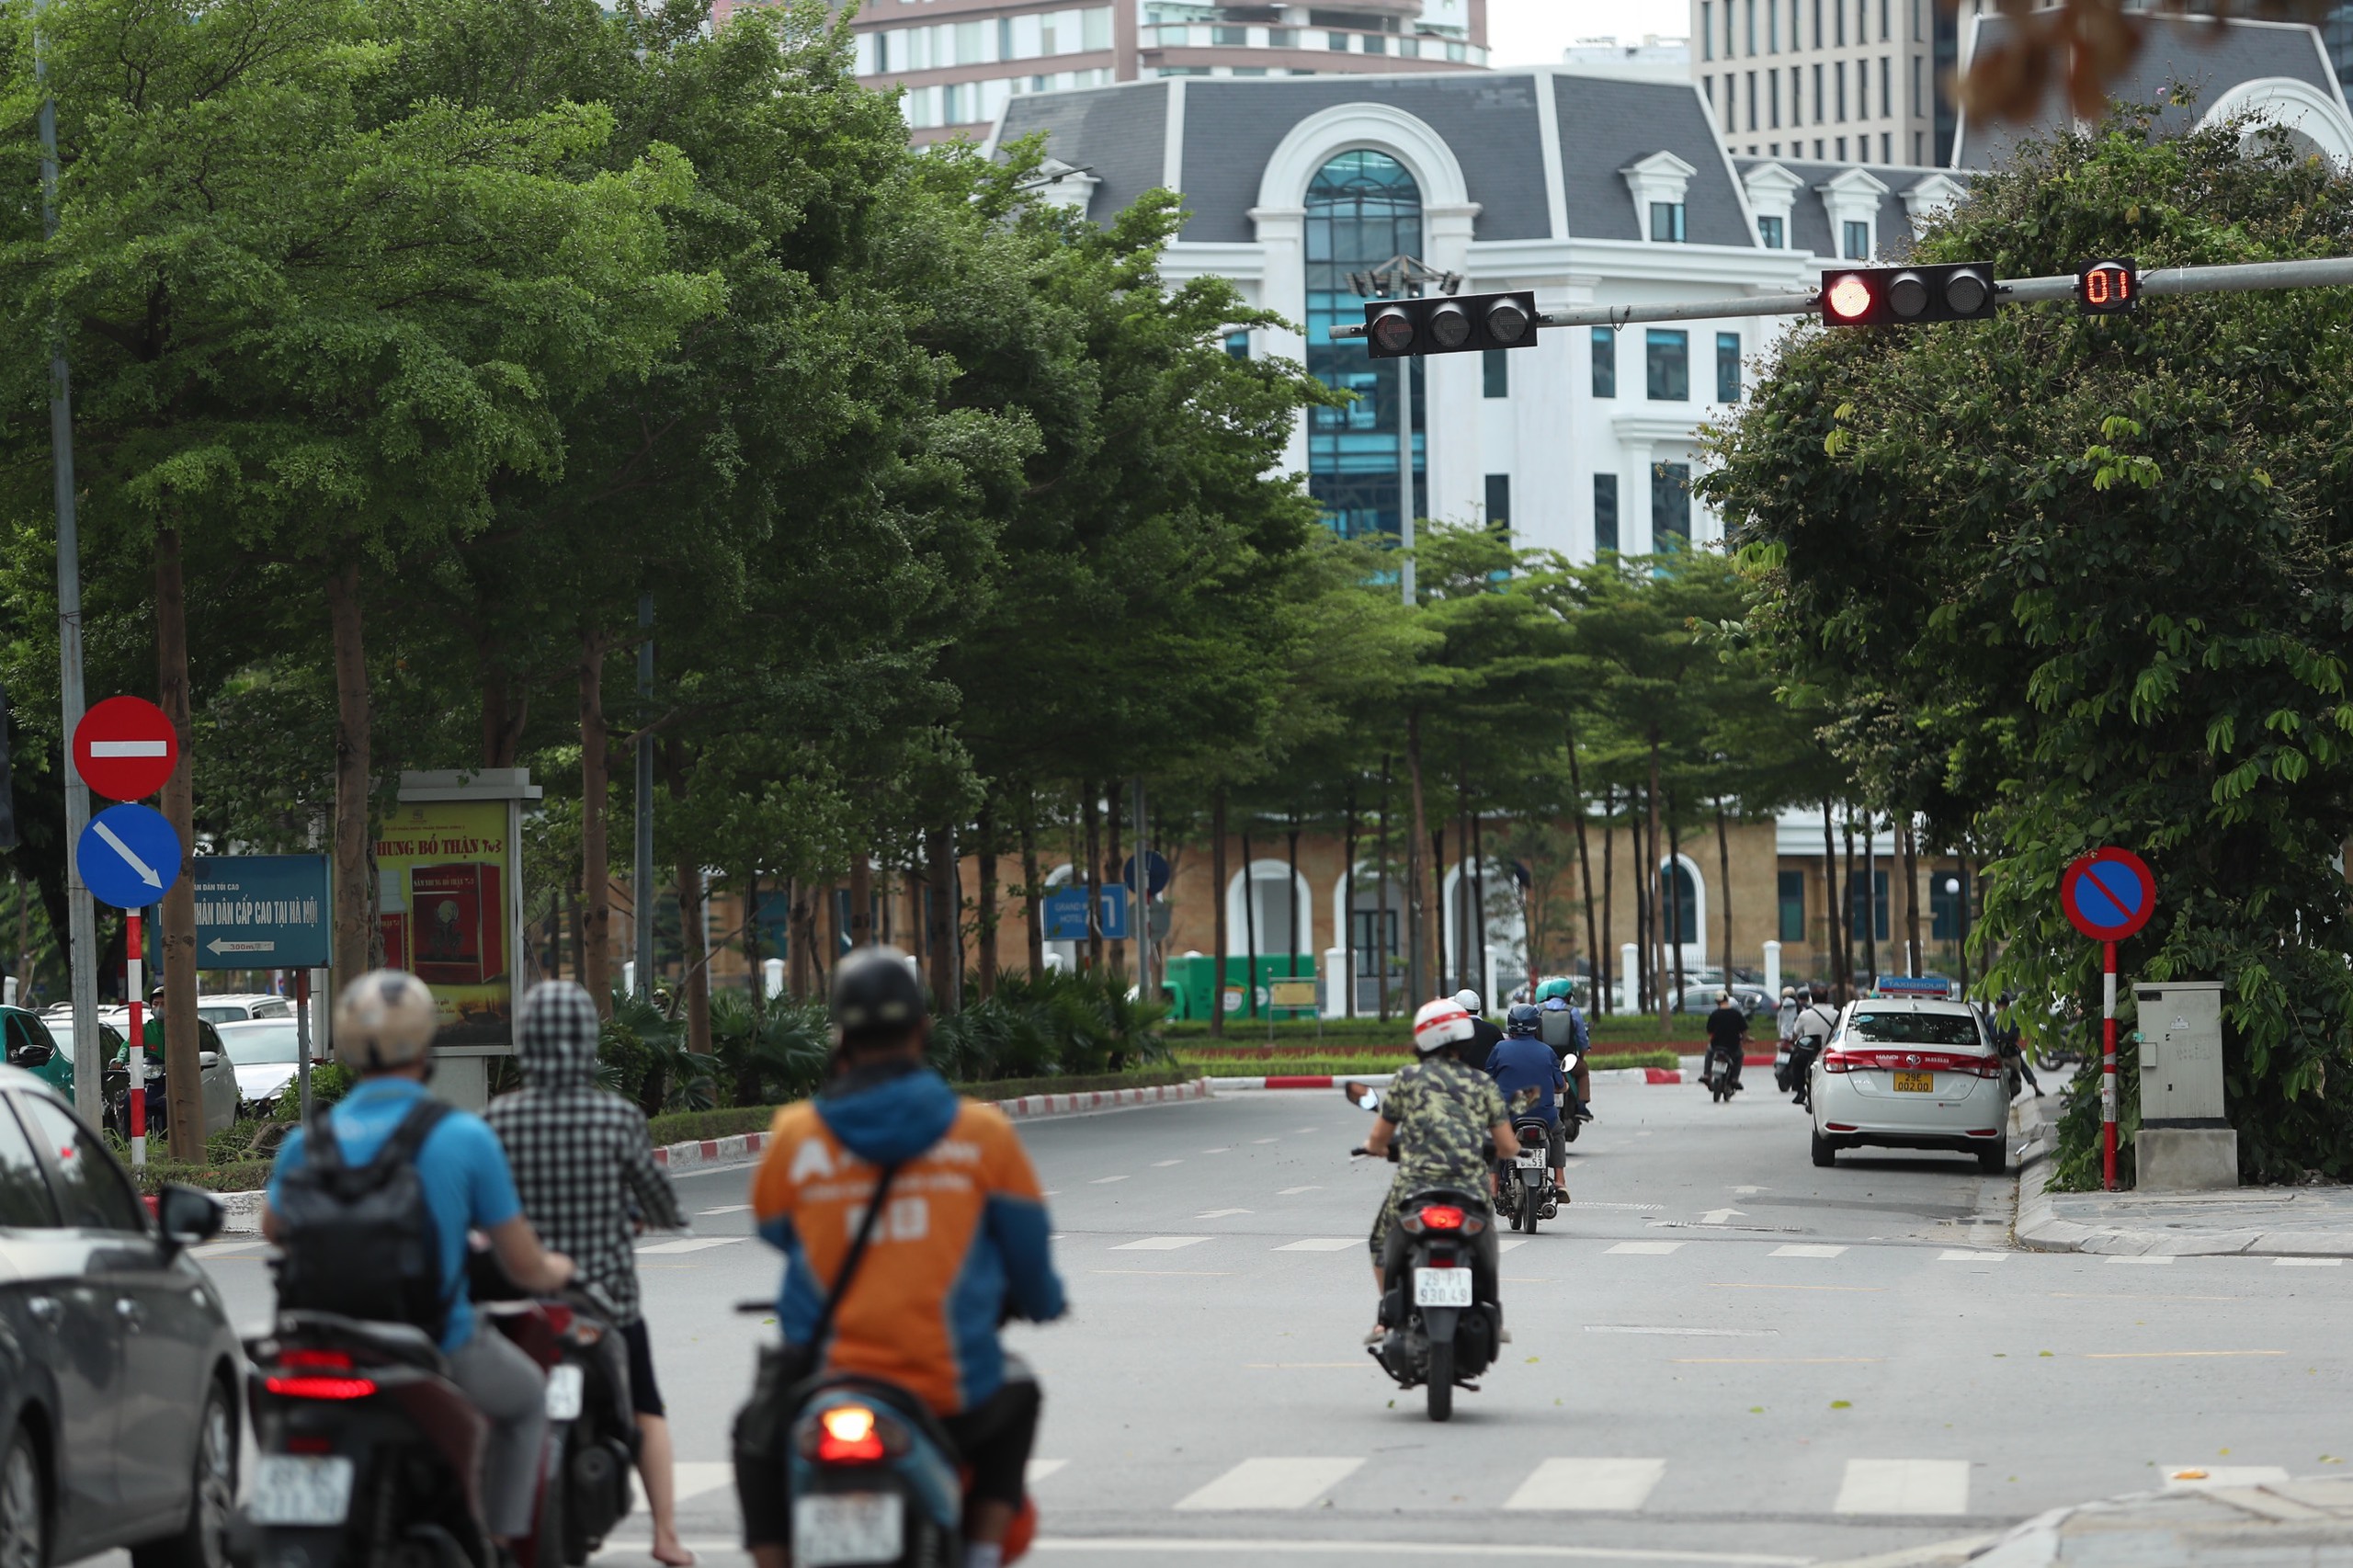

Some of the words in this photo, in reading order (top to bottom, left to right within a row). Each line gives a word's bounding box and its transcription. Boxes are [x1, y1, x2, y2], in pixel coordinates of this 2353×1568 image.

[2087, 270, 2127, 303] 01
[216, 897, 233, 925] DÂN
[235, 894, 253, 925] CẤP
[255, 901, 272, 924] CAO
[274, 900, 288, 927] TẠI
[289, 897, 301, 923] HÀ
[302, 896, 318, 927] NỘI
[1905, 1073, 1922, 1082] 29E
